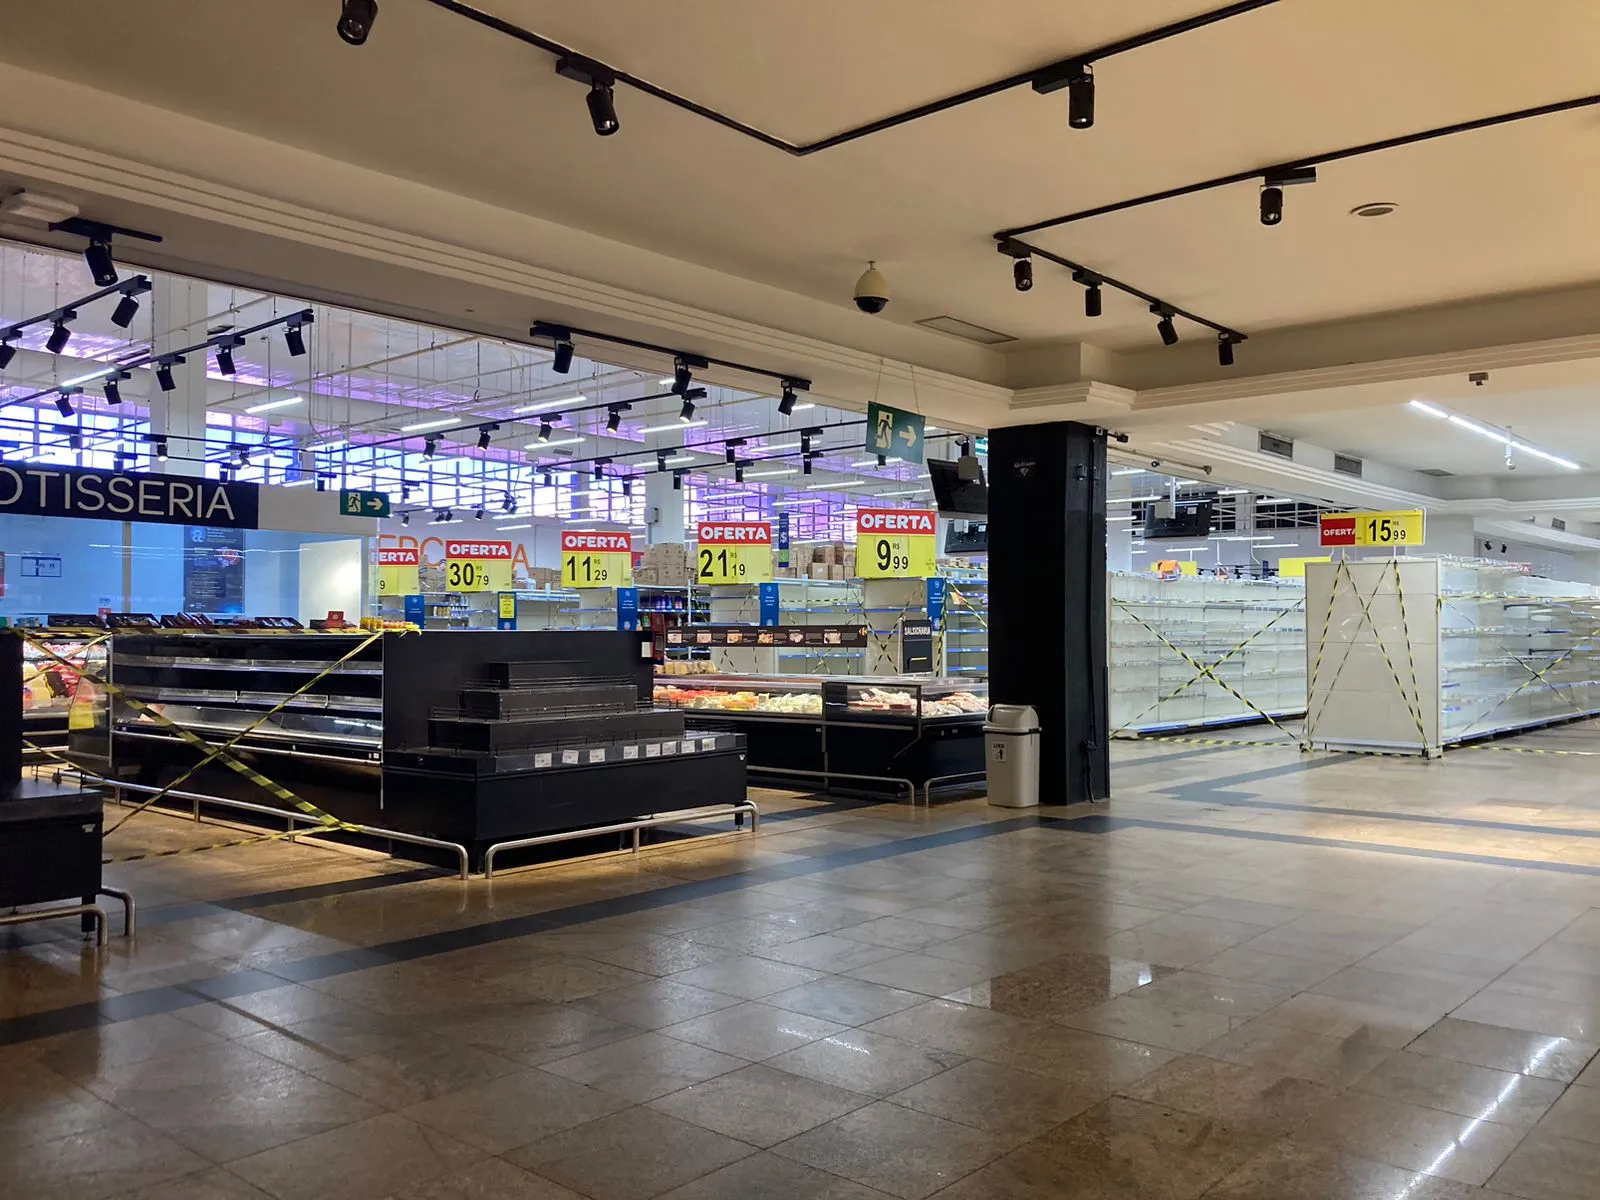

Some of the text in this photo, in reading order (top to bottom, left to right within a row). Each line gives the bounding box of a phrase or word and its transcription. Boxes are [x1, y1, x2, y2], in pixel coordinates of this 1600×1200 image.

[861, 513, 932, 529] OFERTA
[1368, 519, 1406, 541] 15 99
[565, 535, 628, 548] OFERTA
[701, 526, 767, 539] OFERTA
[1323, 528, 1355, 536] OFERTA
[449, 543, 509, 555] OFERTA
[877, 539, 891, 570] 9
[893, 556, 909, 569] 99
[567, 556, 591, 581] 11
[594, 569, 608, 581] 29
[700, 549, 727, 577] 21
[731, 564, 745, 576] 19
[449, 562, 474, 586] 30
[476, 575, 489, 585] 79
